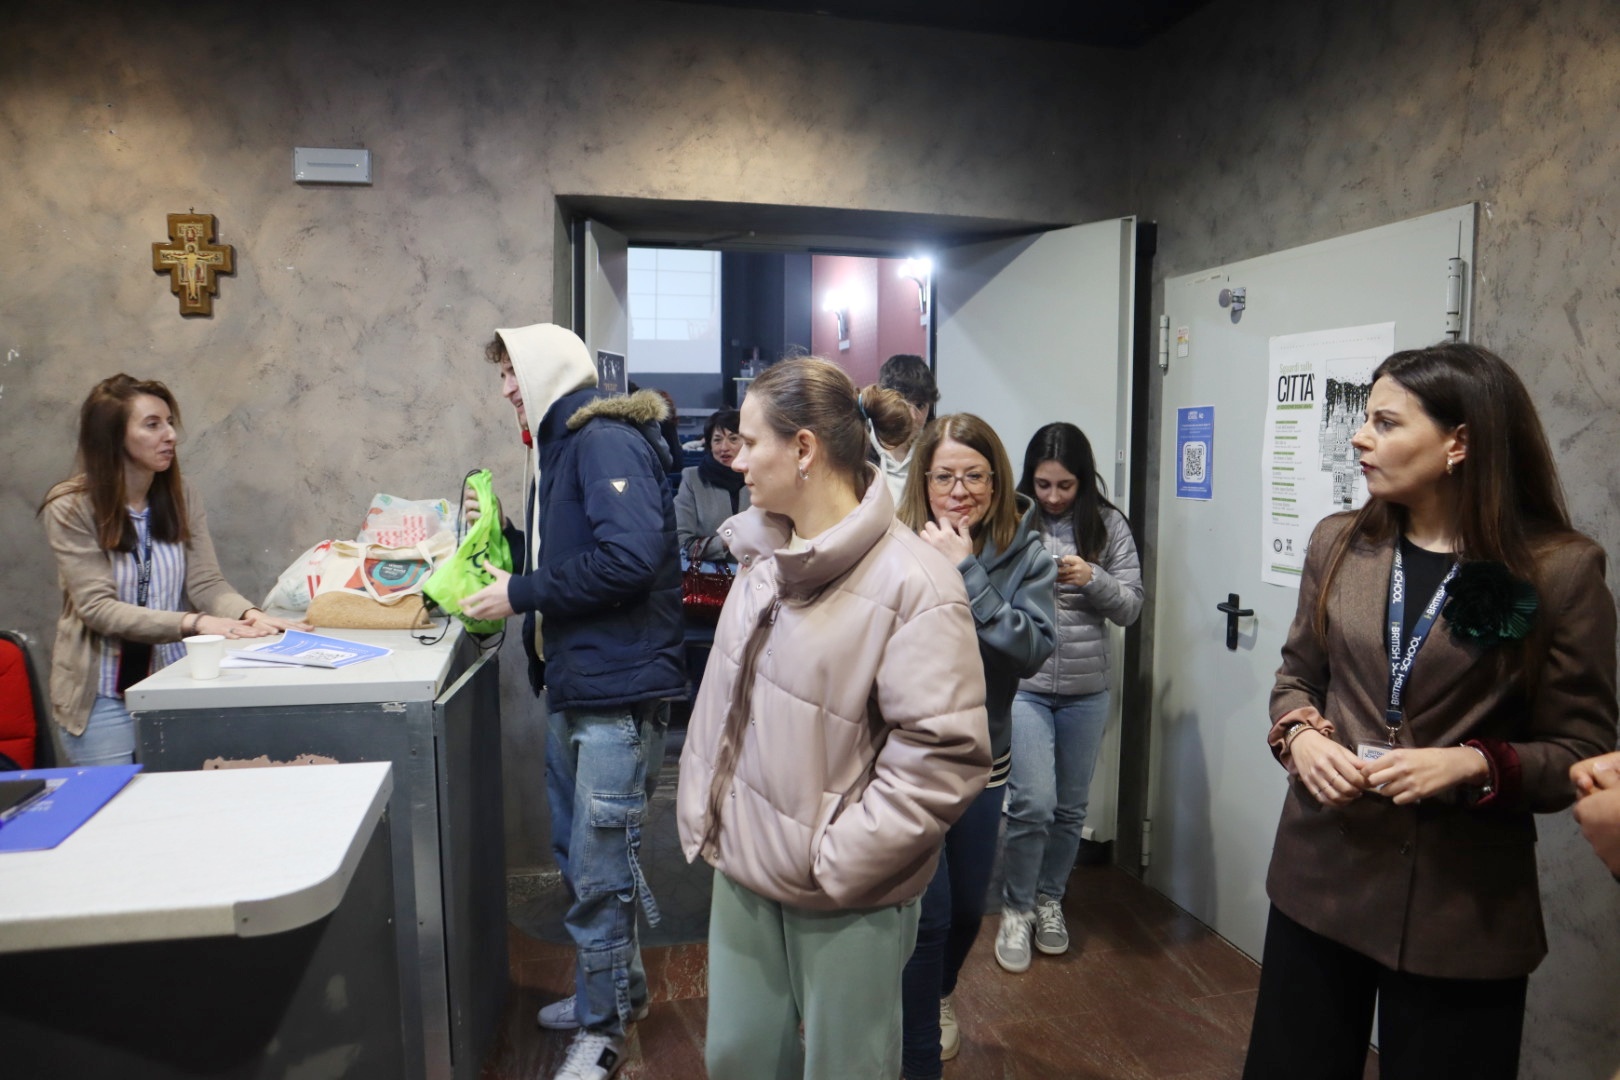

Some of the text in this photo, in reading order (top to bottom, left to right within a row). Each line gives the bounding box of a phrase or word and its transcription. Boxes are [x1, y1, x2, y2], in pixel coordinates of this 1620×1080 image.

[1393, 569, 1403, 604] SCHOOL
[1391, 627, 1401, 660] BRITISH
[1390, 673, 1405, 706] BRITISH
[1400, 635, 1421, 671] SCHOOL
